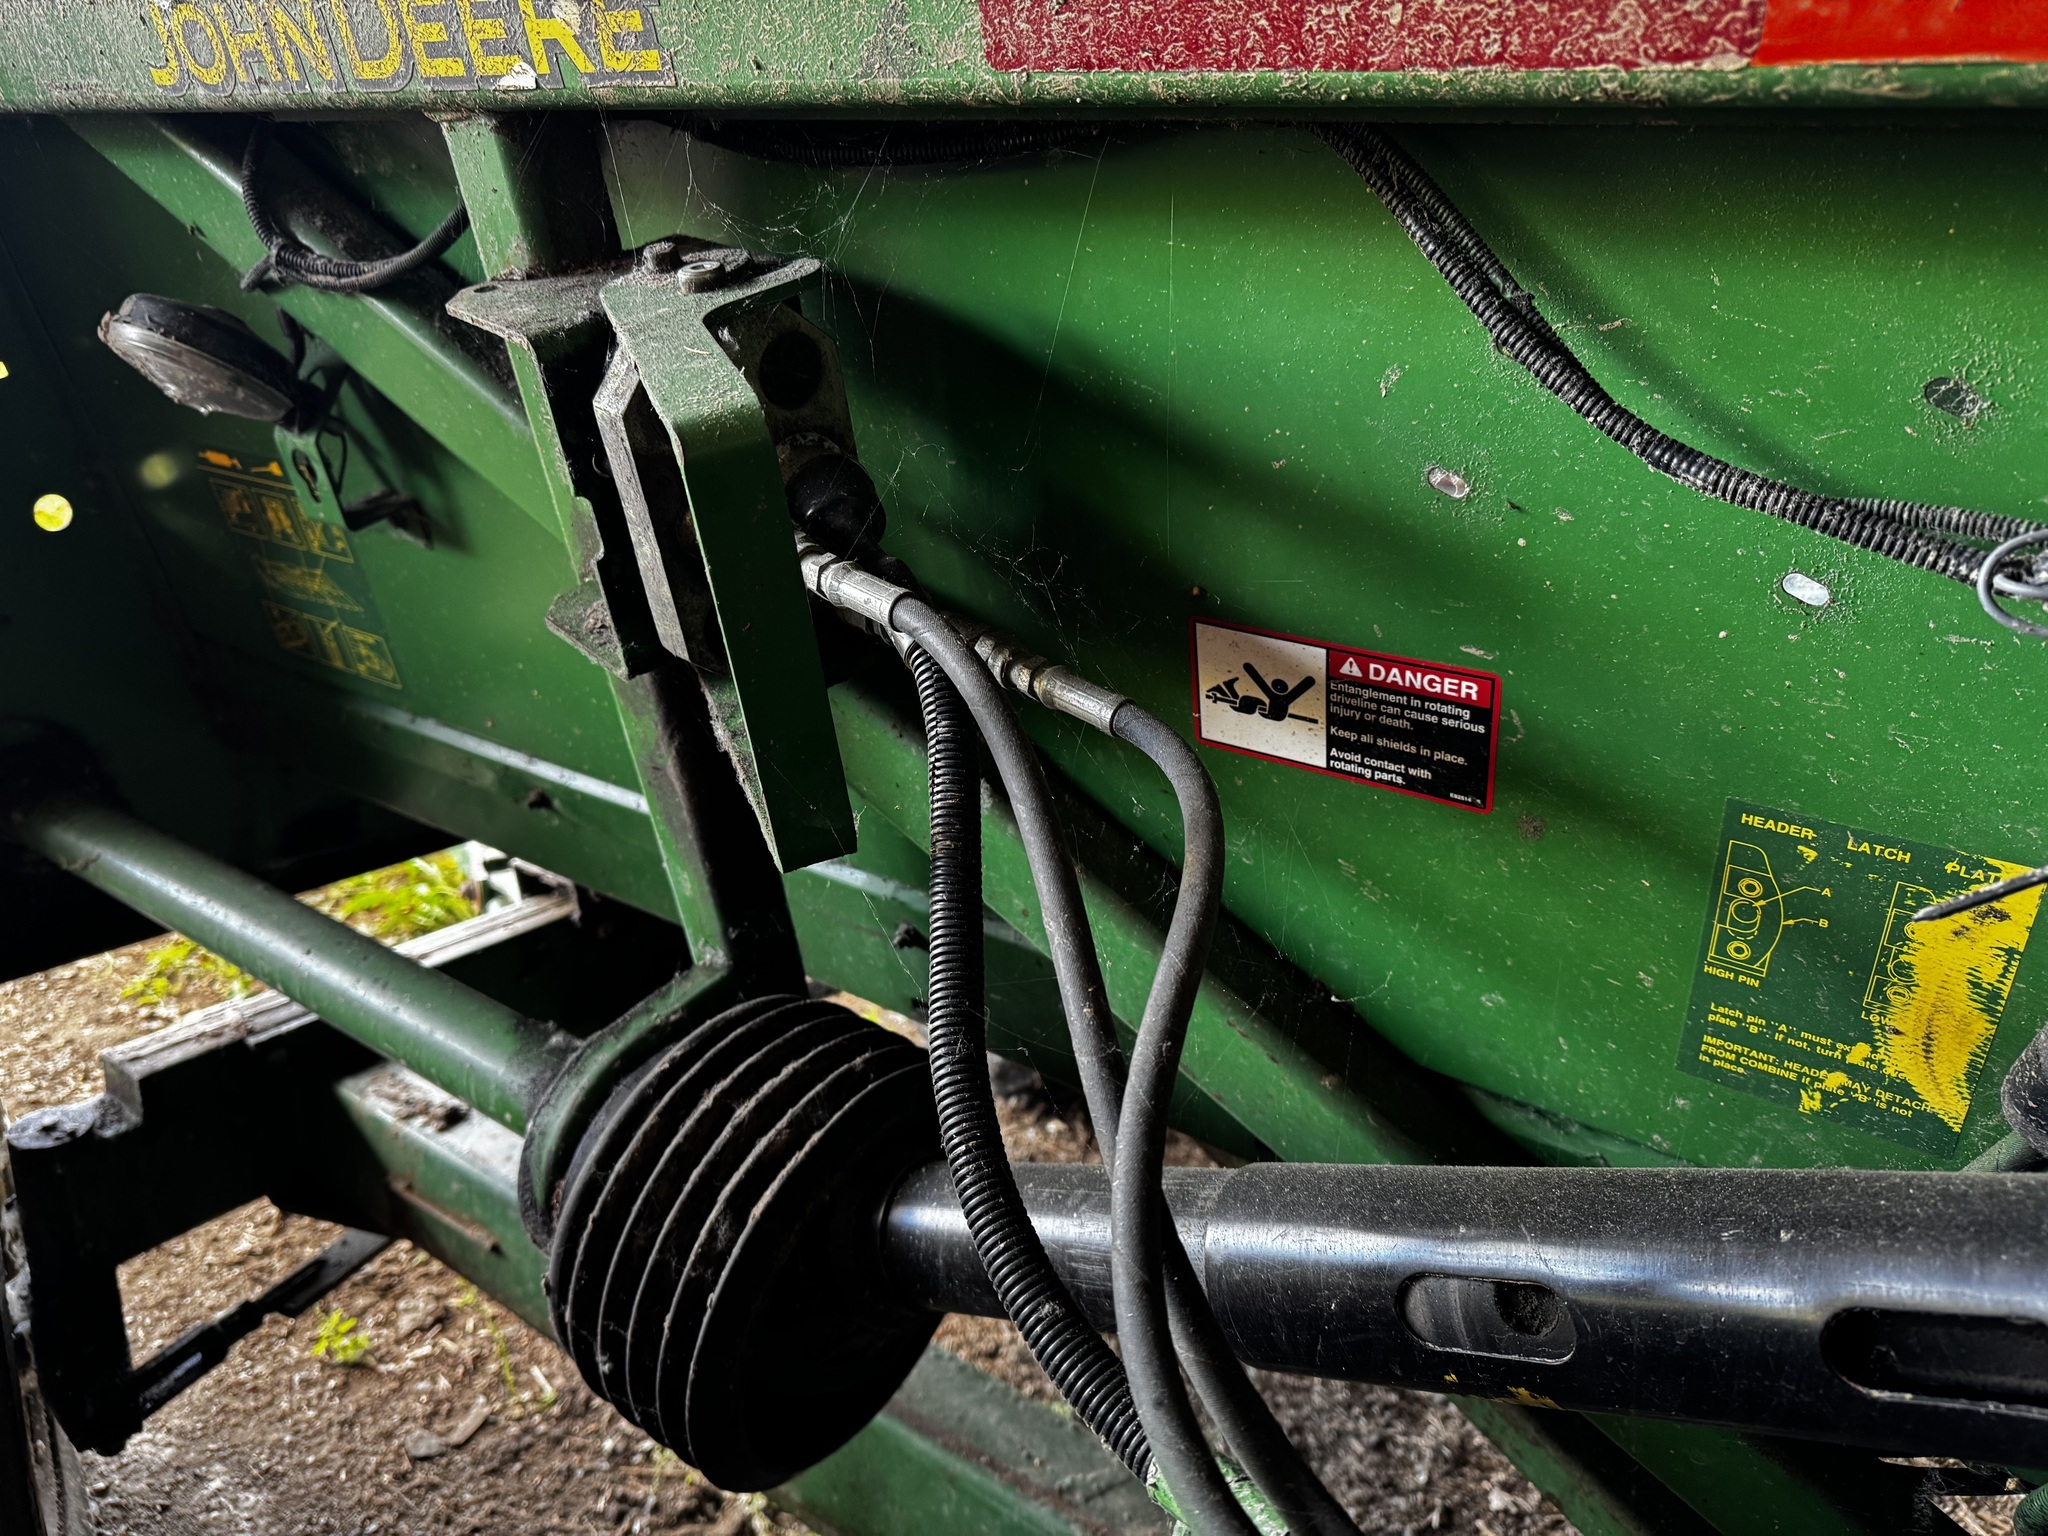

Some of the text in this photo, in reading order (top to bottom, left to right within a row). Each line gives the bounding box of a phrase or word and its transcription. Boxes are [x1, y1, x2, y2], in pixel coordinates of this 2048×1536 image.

[149, 0, 662, 88] JOHN DEERE
[1330, 681, 1471, 720] Entanglement in rotating
[1368, 662, 1479, 701] DANGER
[1330, 693, 1486, 734] driveline can cause serious
[1330, 703, 1414, 730] injury or death.
[1330, 725, 1468, 766] Keep all shields in place.
[1330, 748, 1432, 780] Avoid contact with
[1330, 760, 1406, 785] rotating parts.
[1741, 813, 2006, 884] HEADER LATCH PLAT
[1821, 887, 1832, 898] A
[1818, 918, 1829, 928] B
[1703, 964, 1760, 988] HIGH PIN
[1707, 1013, 1738, 1028] plate
[1774, 1032, 1785, 1042] If
[1787, 1037, 1811, 1051] not,
[1816, 1045, 1842, 1060] turn
[1710, 1002, 1743, 1019] Latch
[1746, 1014, 1766, 1026] pin
[1800, 1031, 1833, 1046] must
[1701, 1043, 1736, 1061] FROM
[1739, 1055, 1799, 1082] COMBINE
[1801, 1075, 1811, 1085] if
[1876, 1099, 1887, 1109] is
[1891, 1103, 1913, 1118] not
[1702, 1034, 1780, 1065] IMPORTANT:
[1784, 1060, 1839, 1083] HEADE
[1875, 1088, 1932, 1113] DETACH
